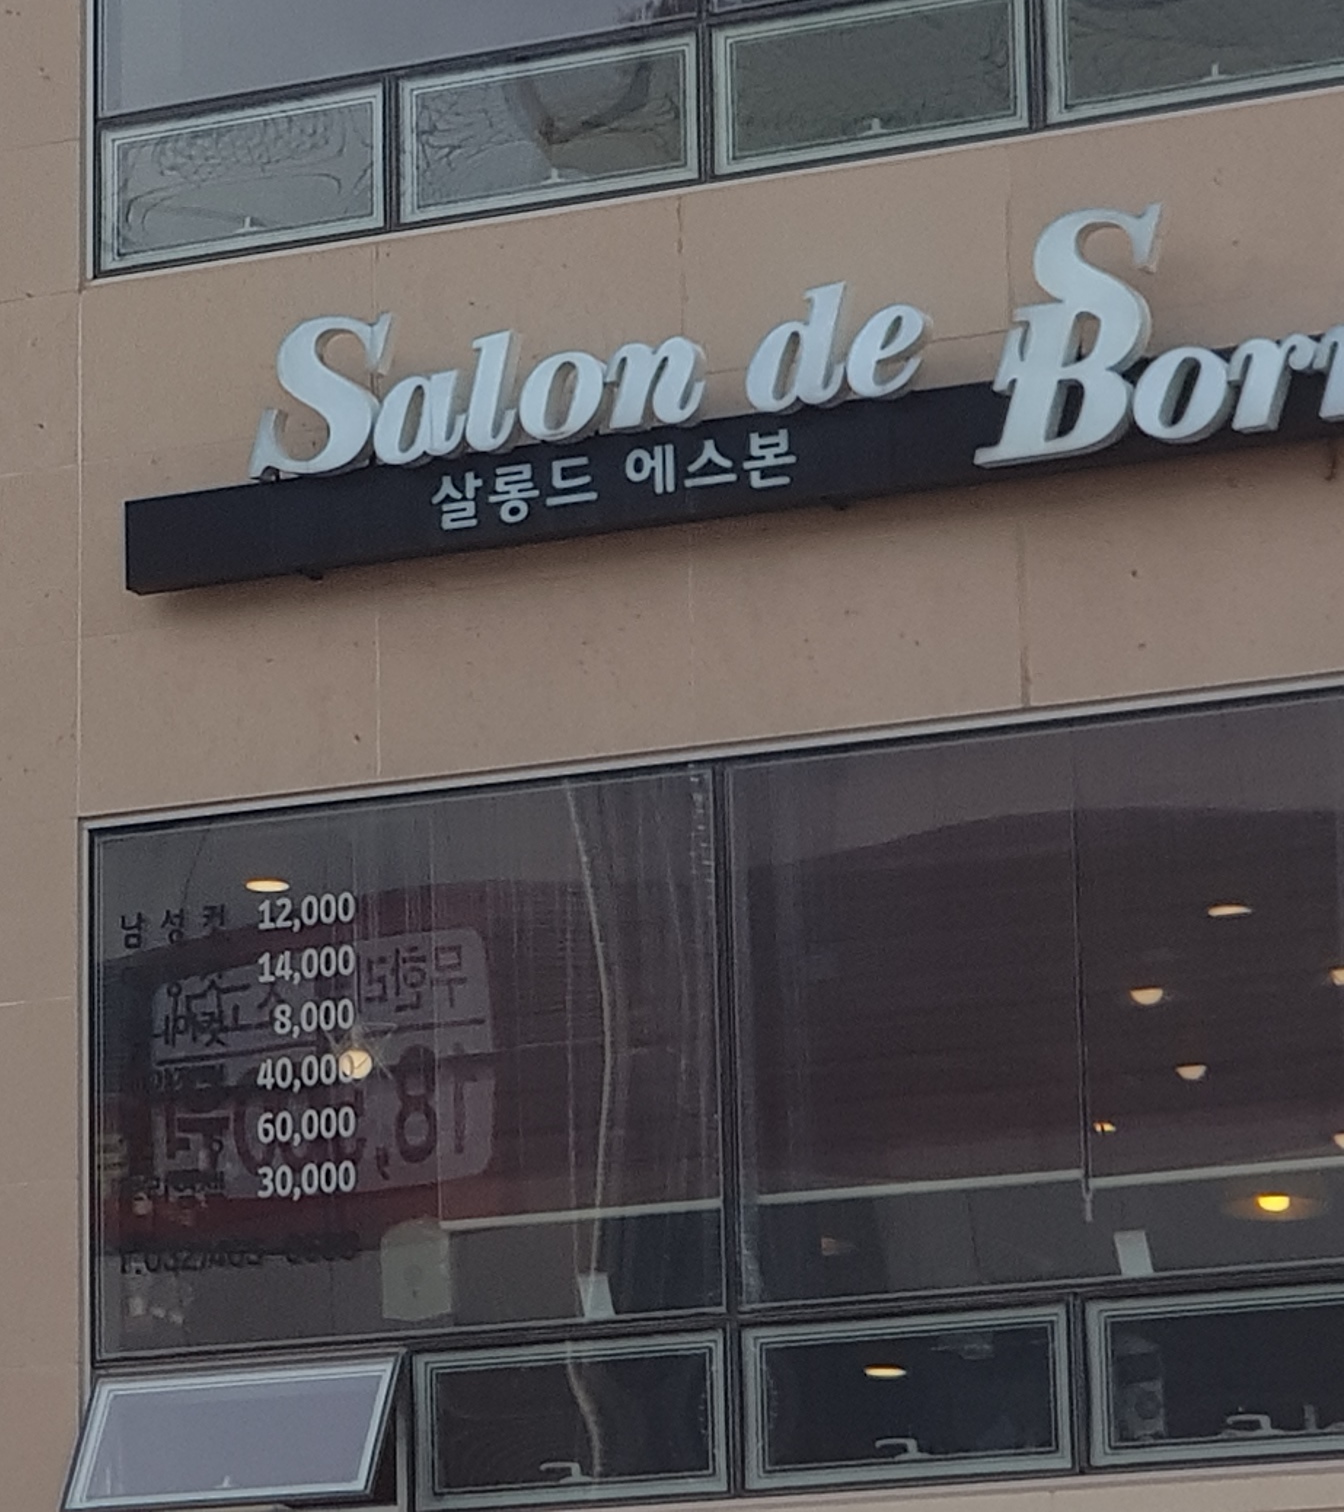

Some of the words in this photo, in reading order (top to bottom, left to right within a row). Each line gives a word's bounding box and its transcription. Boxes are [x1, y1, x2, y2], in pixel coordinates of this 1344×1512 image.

[251, 313, 706, 481] Salon
[746, 281, 933, 415] de
[431, 449, 598, 530] 살롱드
[625, 427, 799, 496] 에스본
[257, 891, 356, 931] 12,000
[257, 945, 356, 985] 14,000
[274, 998, 354, 1035] 8,000
[257, 1107, 356, 1147] 60,000
[257, 1160, 356, 1200] 30,000
